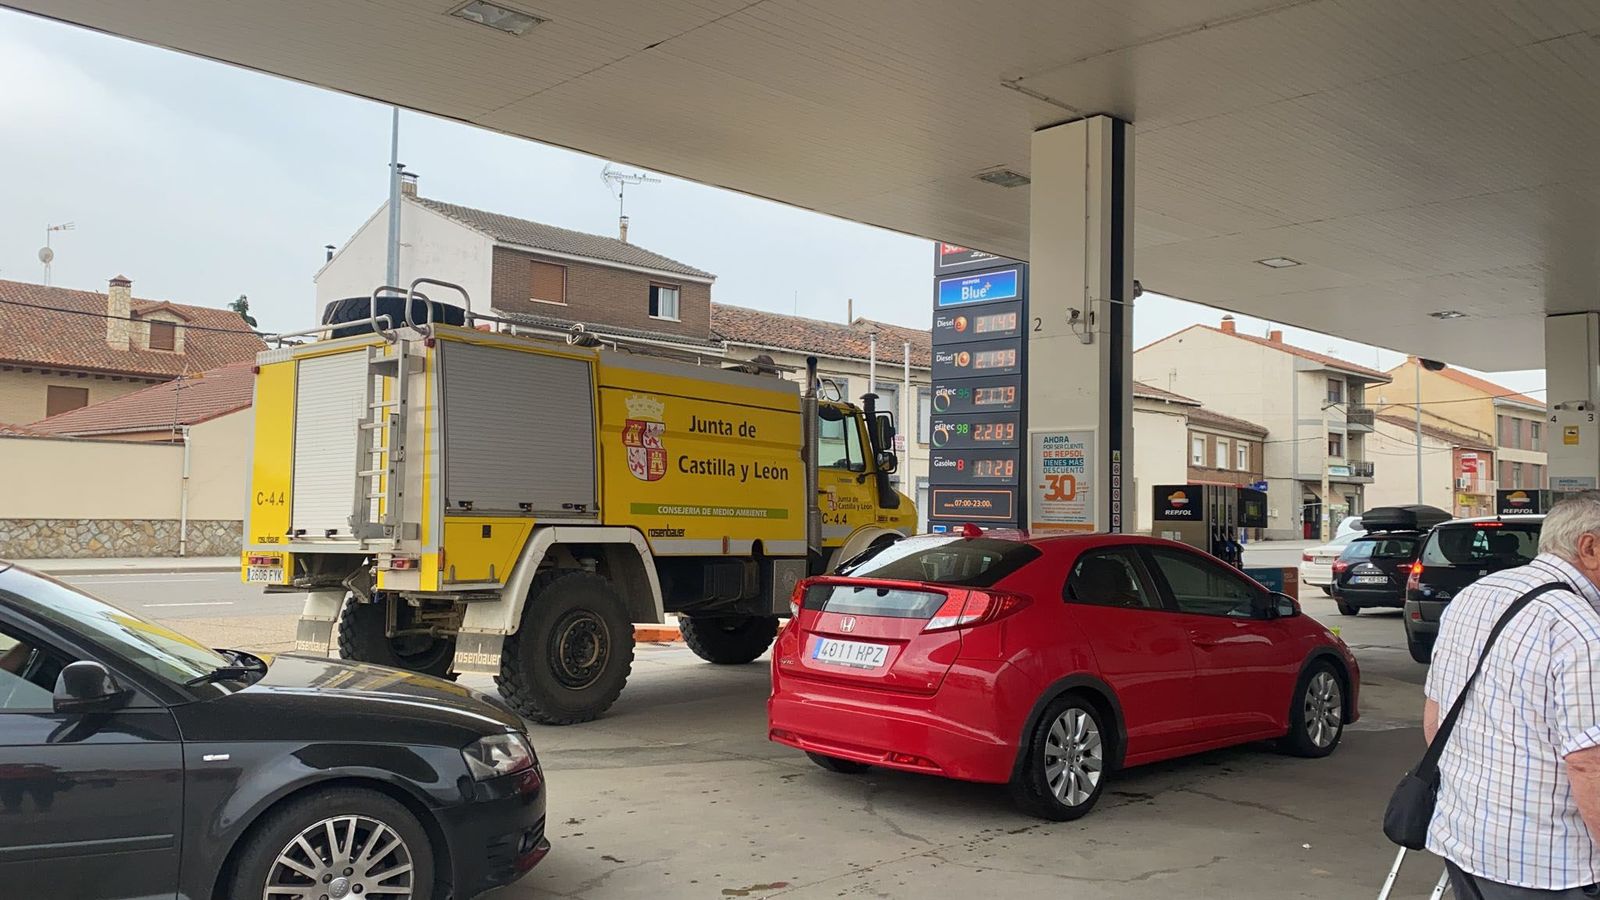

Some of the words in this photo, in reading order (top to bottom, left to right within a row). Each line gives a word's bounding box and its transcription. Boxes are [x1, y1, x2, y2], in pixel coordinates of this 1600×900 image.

[937, 319, 954, 327] Diesel
[1033, 317, 1042, 332] 2
[1089, 311, 1095, 326] 1
[936, 353, 953, 362] Diesel
[1550, 415, 1557, 424] 4
[1587, 413, 1594, 422] 3
[689, 415, 733, 437] Junta
[738, 421, 757, 439] de
[956, 423, 969, 435] 98
[974, 423, 1015, 441] 2.289
[1043, 435, 1070, 444] AHORA
[1044, 458, 1066, 466] TIENES
[678, 455, 736, 477] Castilla
[740, 464, 750, 483] y
[754, 461, 789, 481] León
[1043, 466, 1085, 474] DESCUENTO
[1039, 474, 1077, 501] -30
[256, 491, 285, 506] C-4.4
[702, 508, 713, 516] DE
[714, 508, 734, 516] MEDIO
[735, 509, 768, 518] AMBIENTE
[821, 513, 848, 525] C-4.4
[647, 524, 686, 538] rosenbauer
[251, 569, 268, 581] 2606
[295, 633, 328, 652] rosenbauer
[454, 643, 501, 666] rosenbauer
[822, 642, 852, 660] 4011
